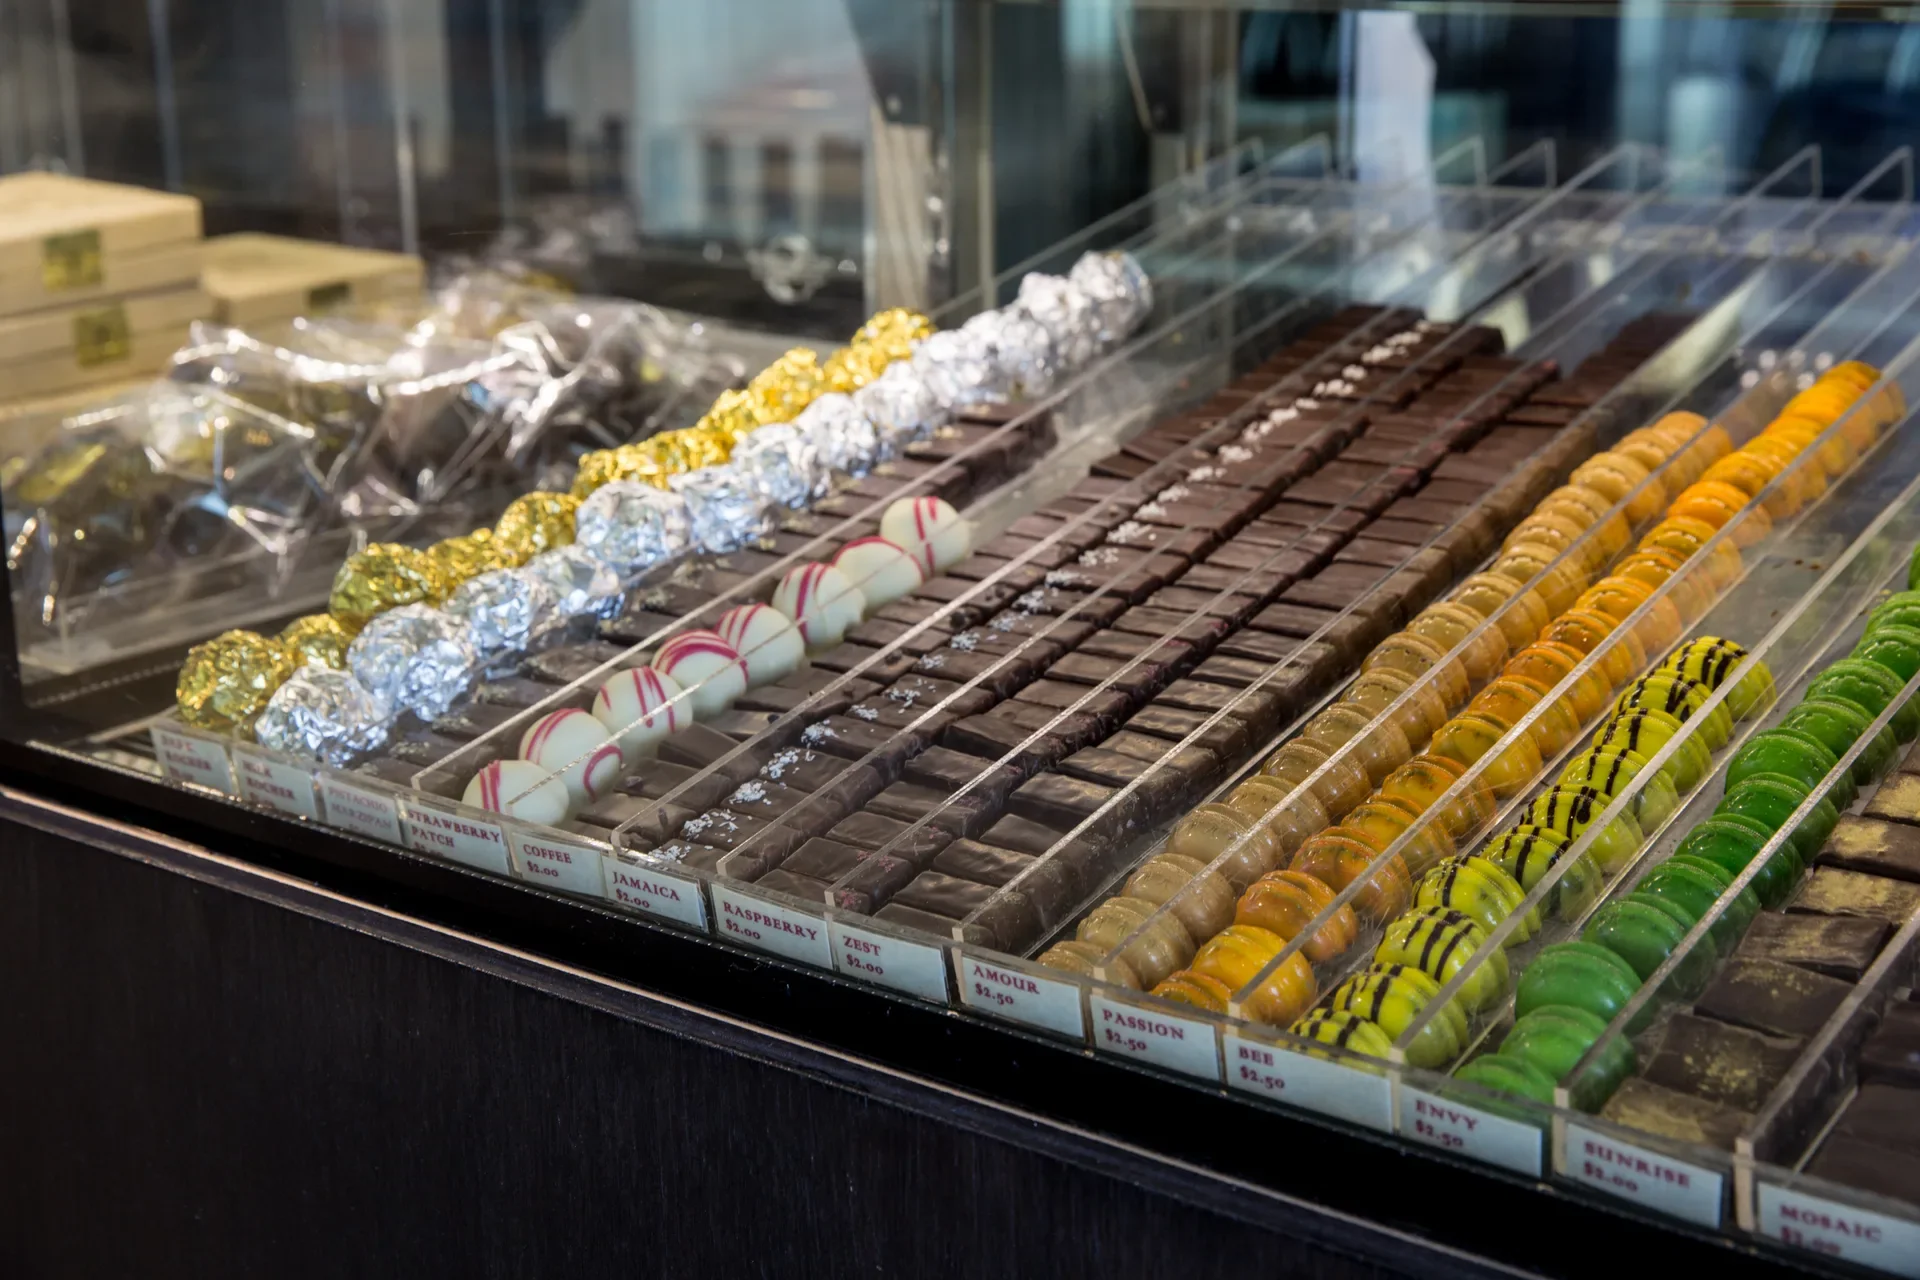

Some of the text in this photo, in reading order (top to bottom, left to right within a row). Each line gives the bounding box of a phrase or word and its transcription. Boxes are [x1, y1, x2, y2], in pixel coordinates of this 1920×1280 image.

[407, 808, 500, 843] STRAWBERRY
[411, 825, 455, 848] PATCH
[523, 843, 572, 865] COFFEE
[527, 860, 559, 878] $2.00
[612, 871, 680, 902] JAMAICA
[615, 889, 650, 909] $2.00
[723, 901, 818, 941] RASPBERRY
[725, 919, 761, 941] $2.00
[843, 935, 882, 957] ZEST
[846, 954, 883, 975] $2.00
[973, 965, 1040, 995] AMOUR
[975, 983, 1014, 1006] $2.50
[1103, 1009, 1185, 1041] PASSION
[1105, 1028, 1147, 1051] $2.50
[1238, 1046, 1274, 1068] BEE
[1240, 1066, 1285, 1090] $2.50
[1414, 1099, 1478, 1131] ENVY
[1415, 1120, 1464, 1147] $2.50
[1584, 1141, 1691, 1189] SUNRISE
[1779, 1204, 1882, 1243] MOSAIC
